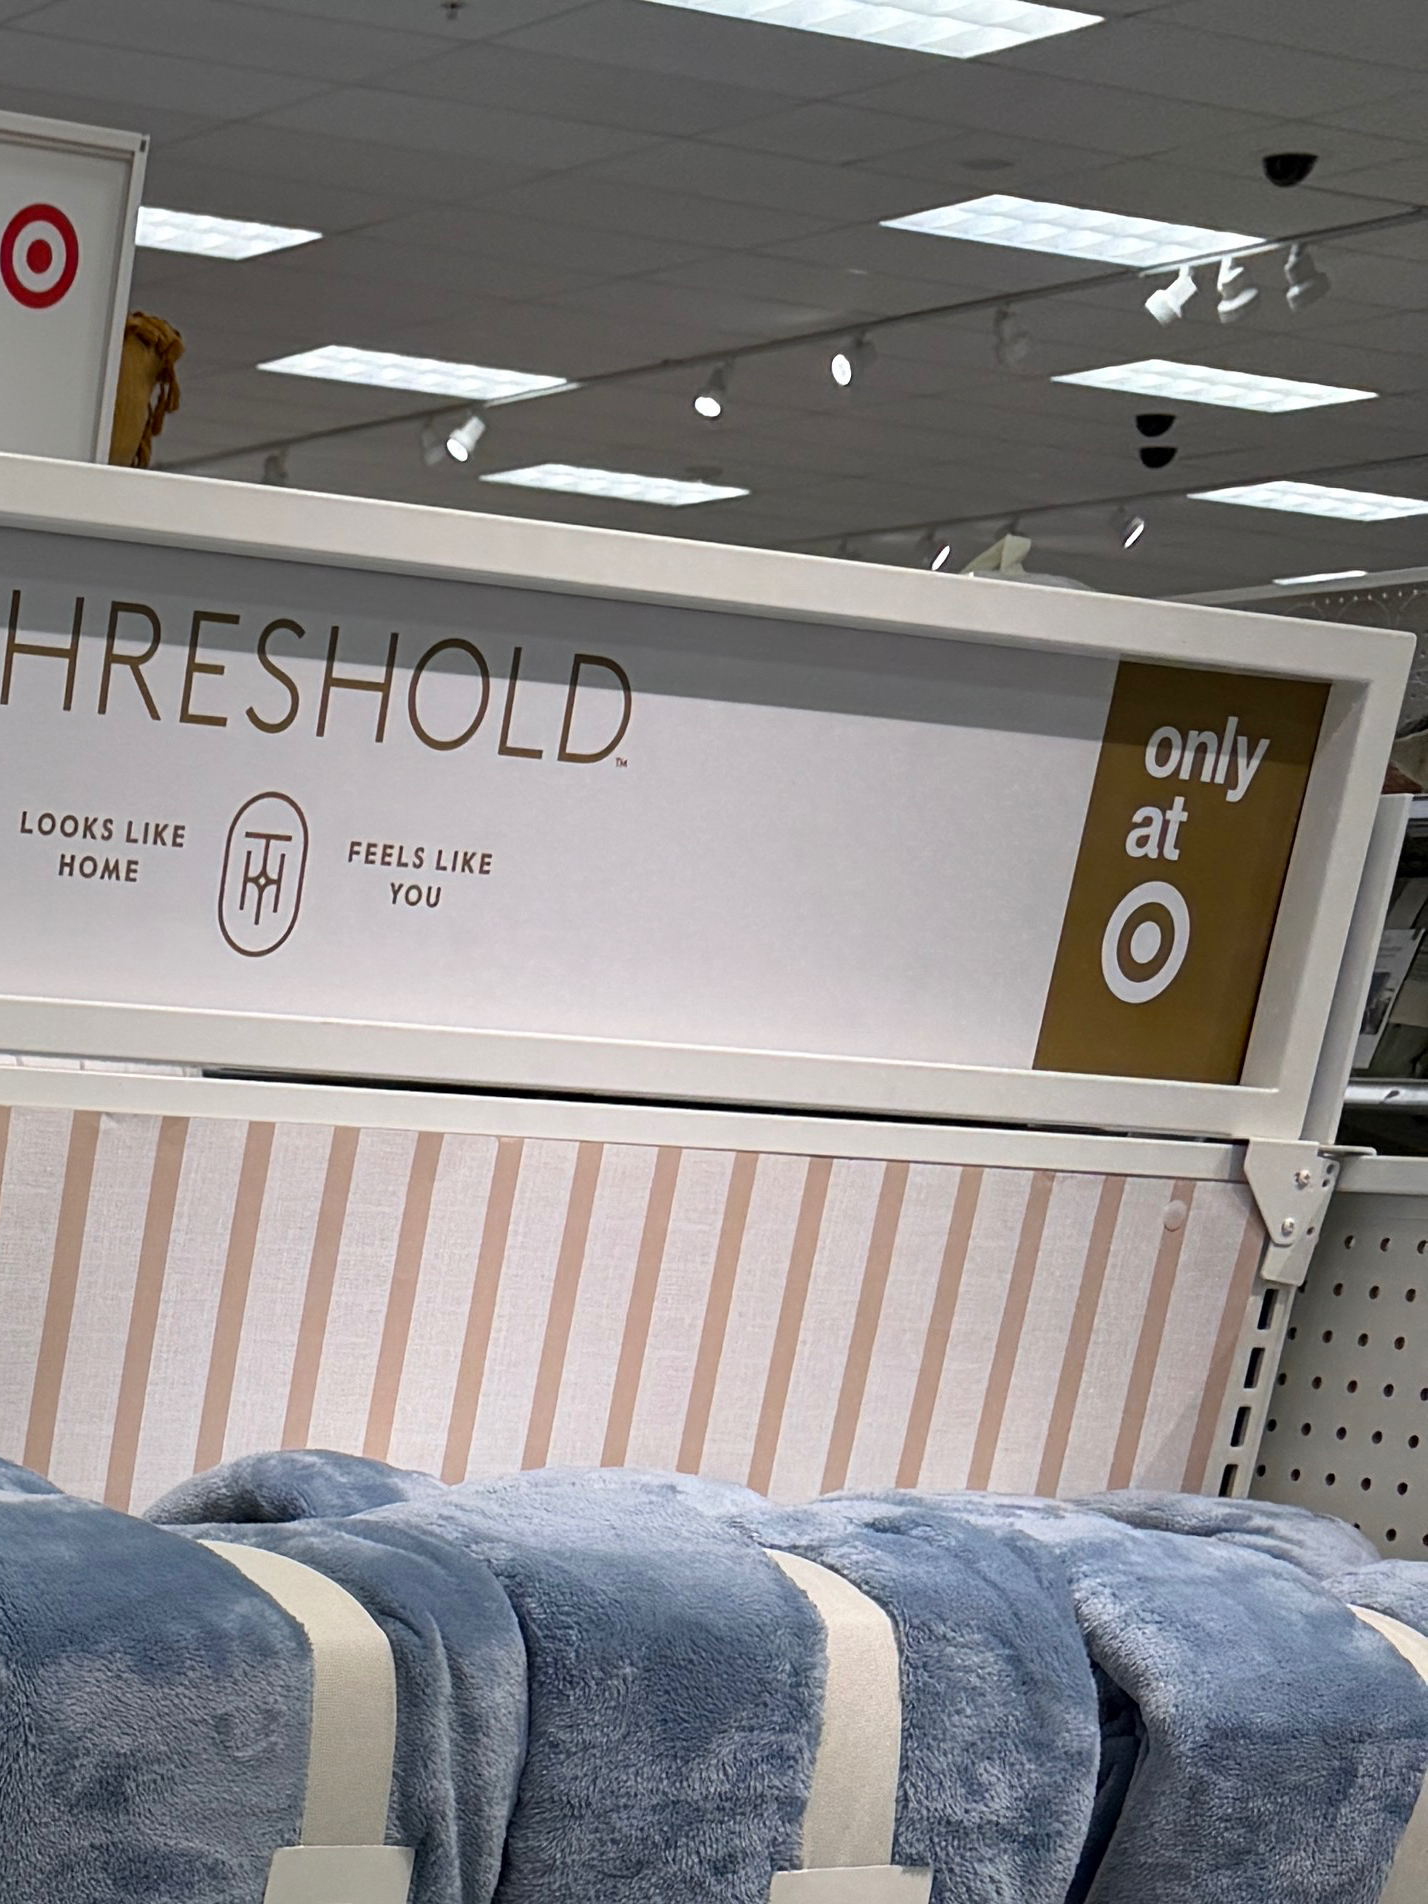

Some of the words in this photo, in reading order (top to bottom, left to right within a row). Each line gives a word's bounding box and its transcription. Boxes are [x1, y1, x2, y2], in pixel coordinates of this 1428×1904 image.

[1145, 716, 1270, 802] only
[19, 810, 115, 842] LOOKS
[125, 820, 187, 848] LIKE
[1125, 796, 1188, 860] at
[58, 853, 140, 882] HOME
[347, 840, 426, 870] FEELS
[435, 848, 494, 876] LIKE
[388, 882, 443, 909] YOU
